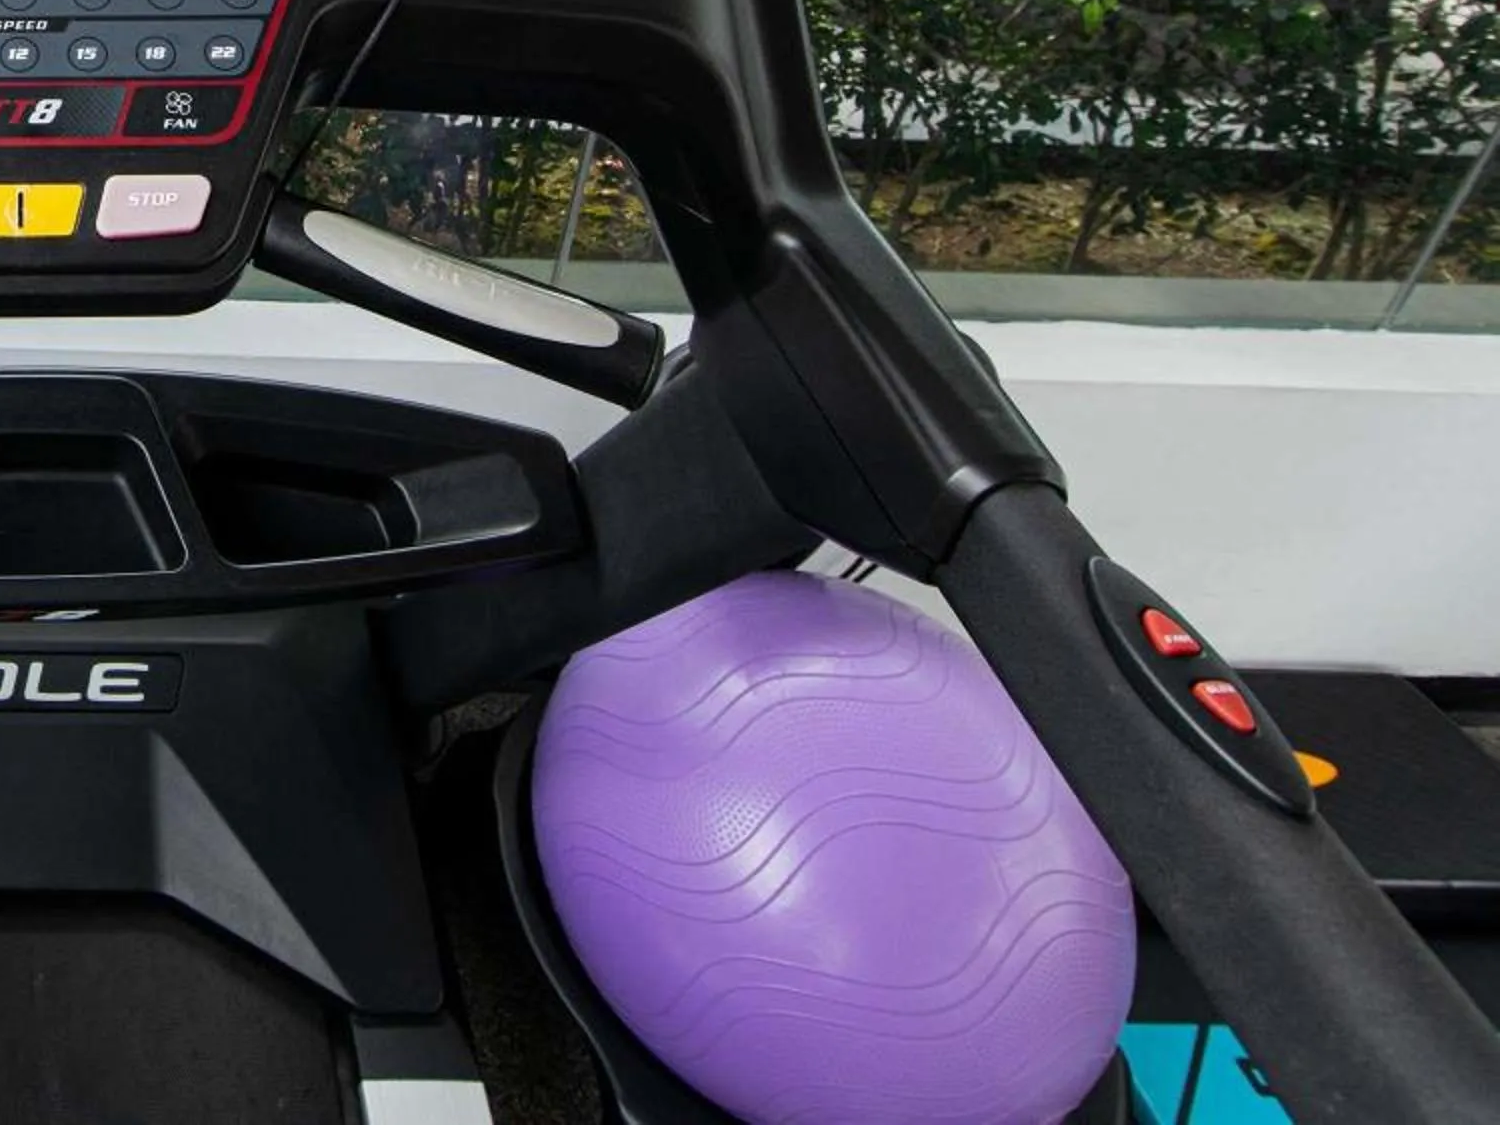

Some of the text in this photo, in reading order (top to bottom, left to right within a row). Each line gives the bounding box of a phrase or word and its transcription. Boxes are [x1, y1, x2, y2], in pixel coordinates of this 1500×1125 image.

[7, 47, 30, 61] 12
[76, 46, 98, 61] 15
[144, 45, 167, 60] 18
[210, 45, 237, 59] 22
[163, 117, 198, 130] FAN
[128, 191, 179, 207] STOP
